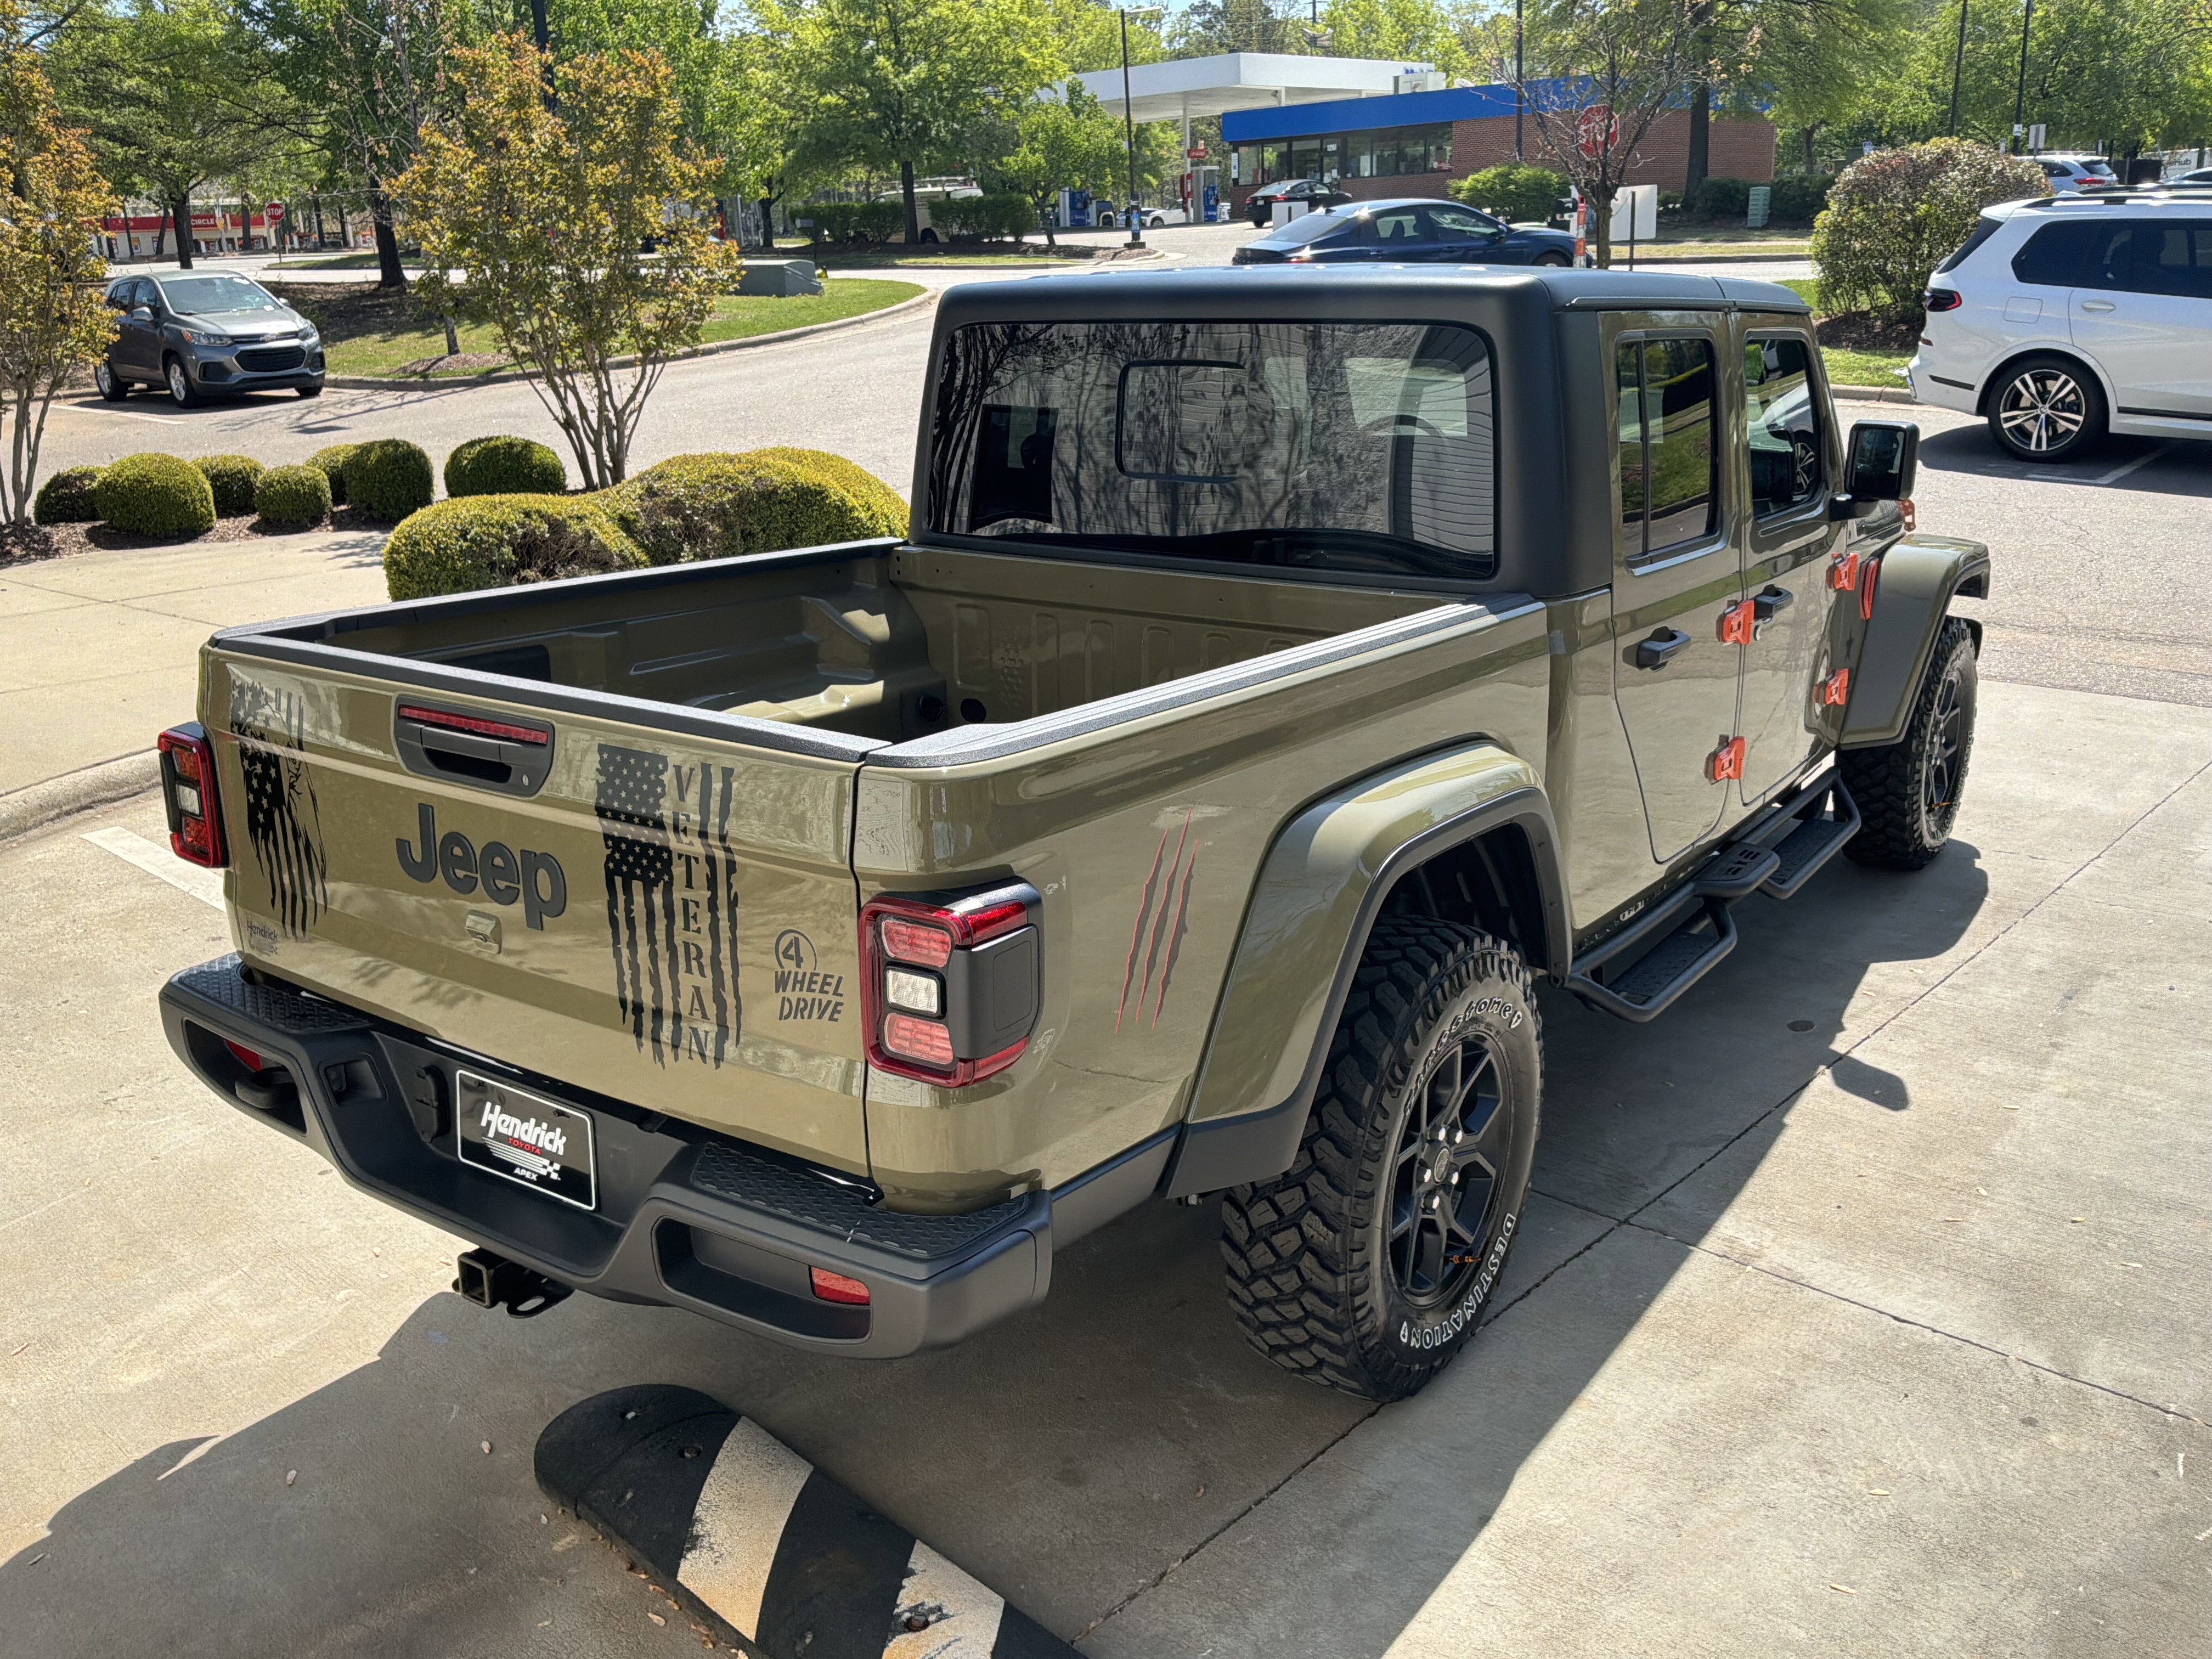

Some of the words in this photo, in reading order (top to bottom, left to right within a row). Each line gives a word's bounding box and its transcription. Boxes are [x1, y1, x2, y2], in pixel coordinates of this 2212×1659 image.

[266, 207, 283, 216] STOP
[396, 803, 567, 931] Jeep
[673, 764, 710, 1064] VETERAN
[782, 936, 804, 969] 4
[775, 970, 844, 997] WHEEL
[778, 996, 844, 1023] DRIVE
[481, 1101, 567, 1156] Hendrick
[508, 1137, 541, 1155] TOYOTA
[513, 1167, 539, 1181] APEX
[1410, 1213, 1516, 1349] DESTINATION
